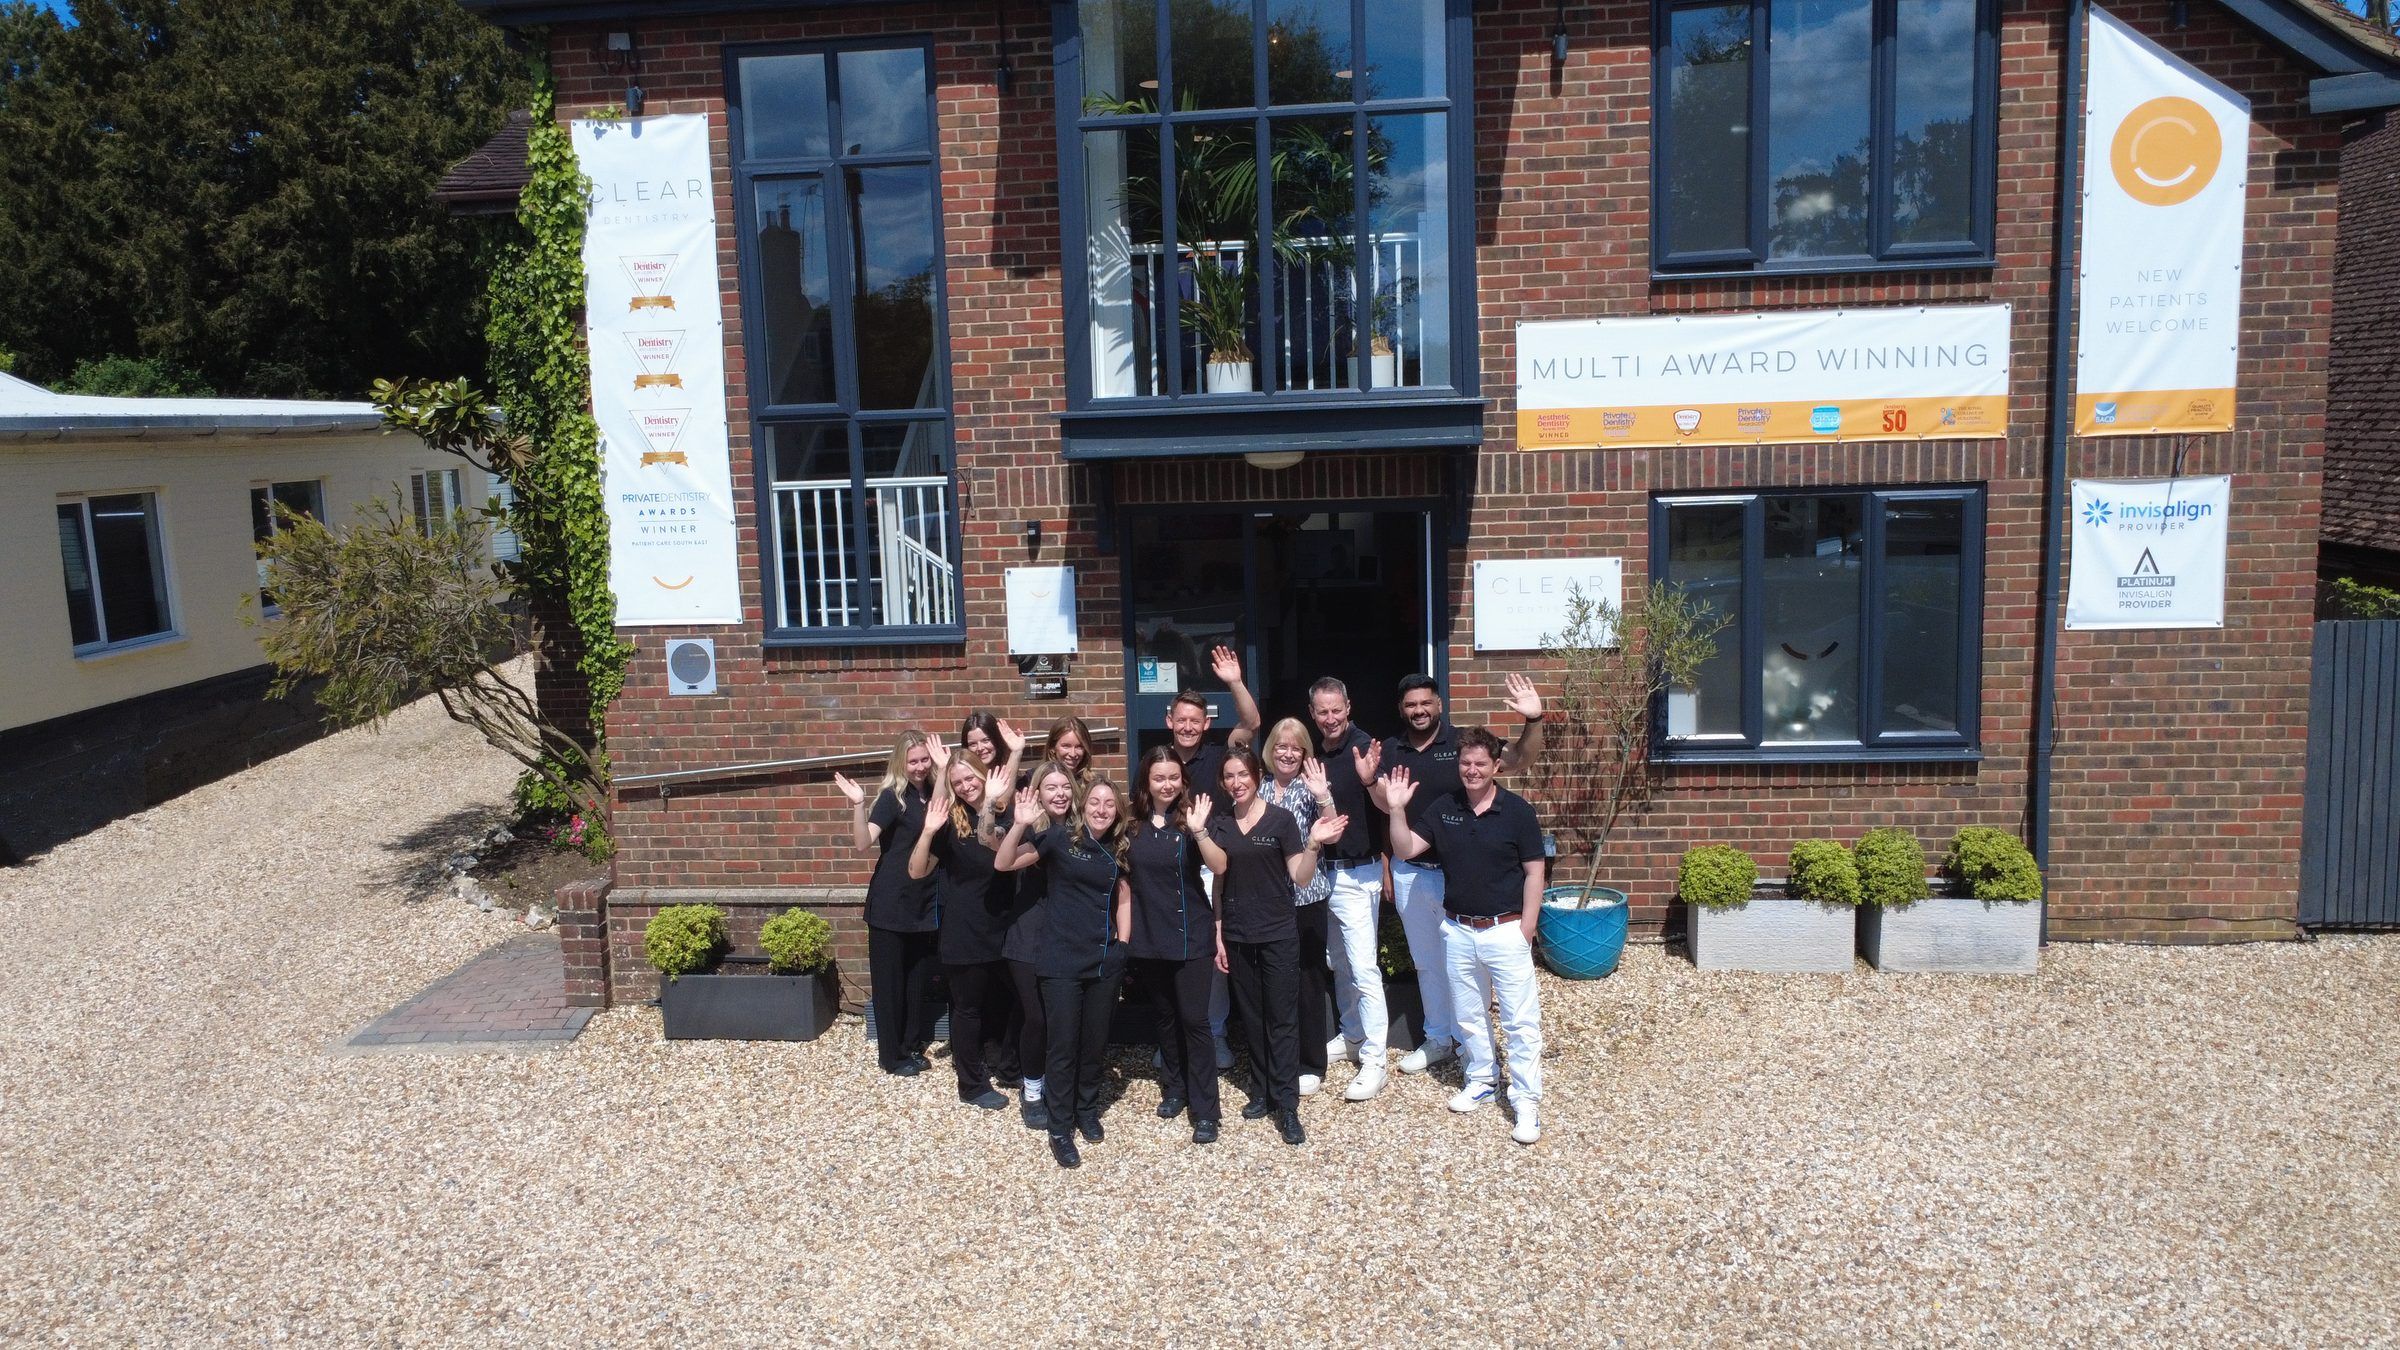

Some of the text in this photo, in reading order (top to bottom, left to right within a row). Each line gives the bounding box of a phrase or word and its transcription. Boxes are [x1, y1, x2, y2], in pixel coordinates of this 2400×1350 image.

[589, 178, 703, 204] CLEAR
[604, 213, 689, 225] DENTISTRY
[633, 261, 667, 272] Dentistry
[2138, 269, 2182, 282] NEW
[2110, 293, 2208, 309] PATIENTS
[2106, 318, 2209, 334] WELCOME
[638, 338, 673, 349] Dentistry
[1533, 343, 1989, 380] MULTI AWARD WINNING
[644, 416, 679, 428] Dentistry
[1537, 420, 1570, 428] Dentistry
[1883, 409, 1907, 432] 50
[639, 507, 697, 516] AWARDS
[2119, 500, 2212, 521] invisalign
[641, 525, 697, 534] WINNER
[2119, 522, 2185, 532] PROVIDER
[1492, 575, 1604, 595] CLEAR
[2120, 577, 2172, 587] PLATINUM
[2118, 590, 2172, 599] INVISALIGN
[2118, 600, 2172, 609] PROVIDER
